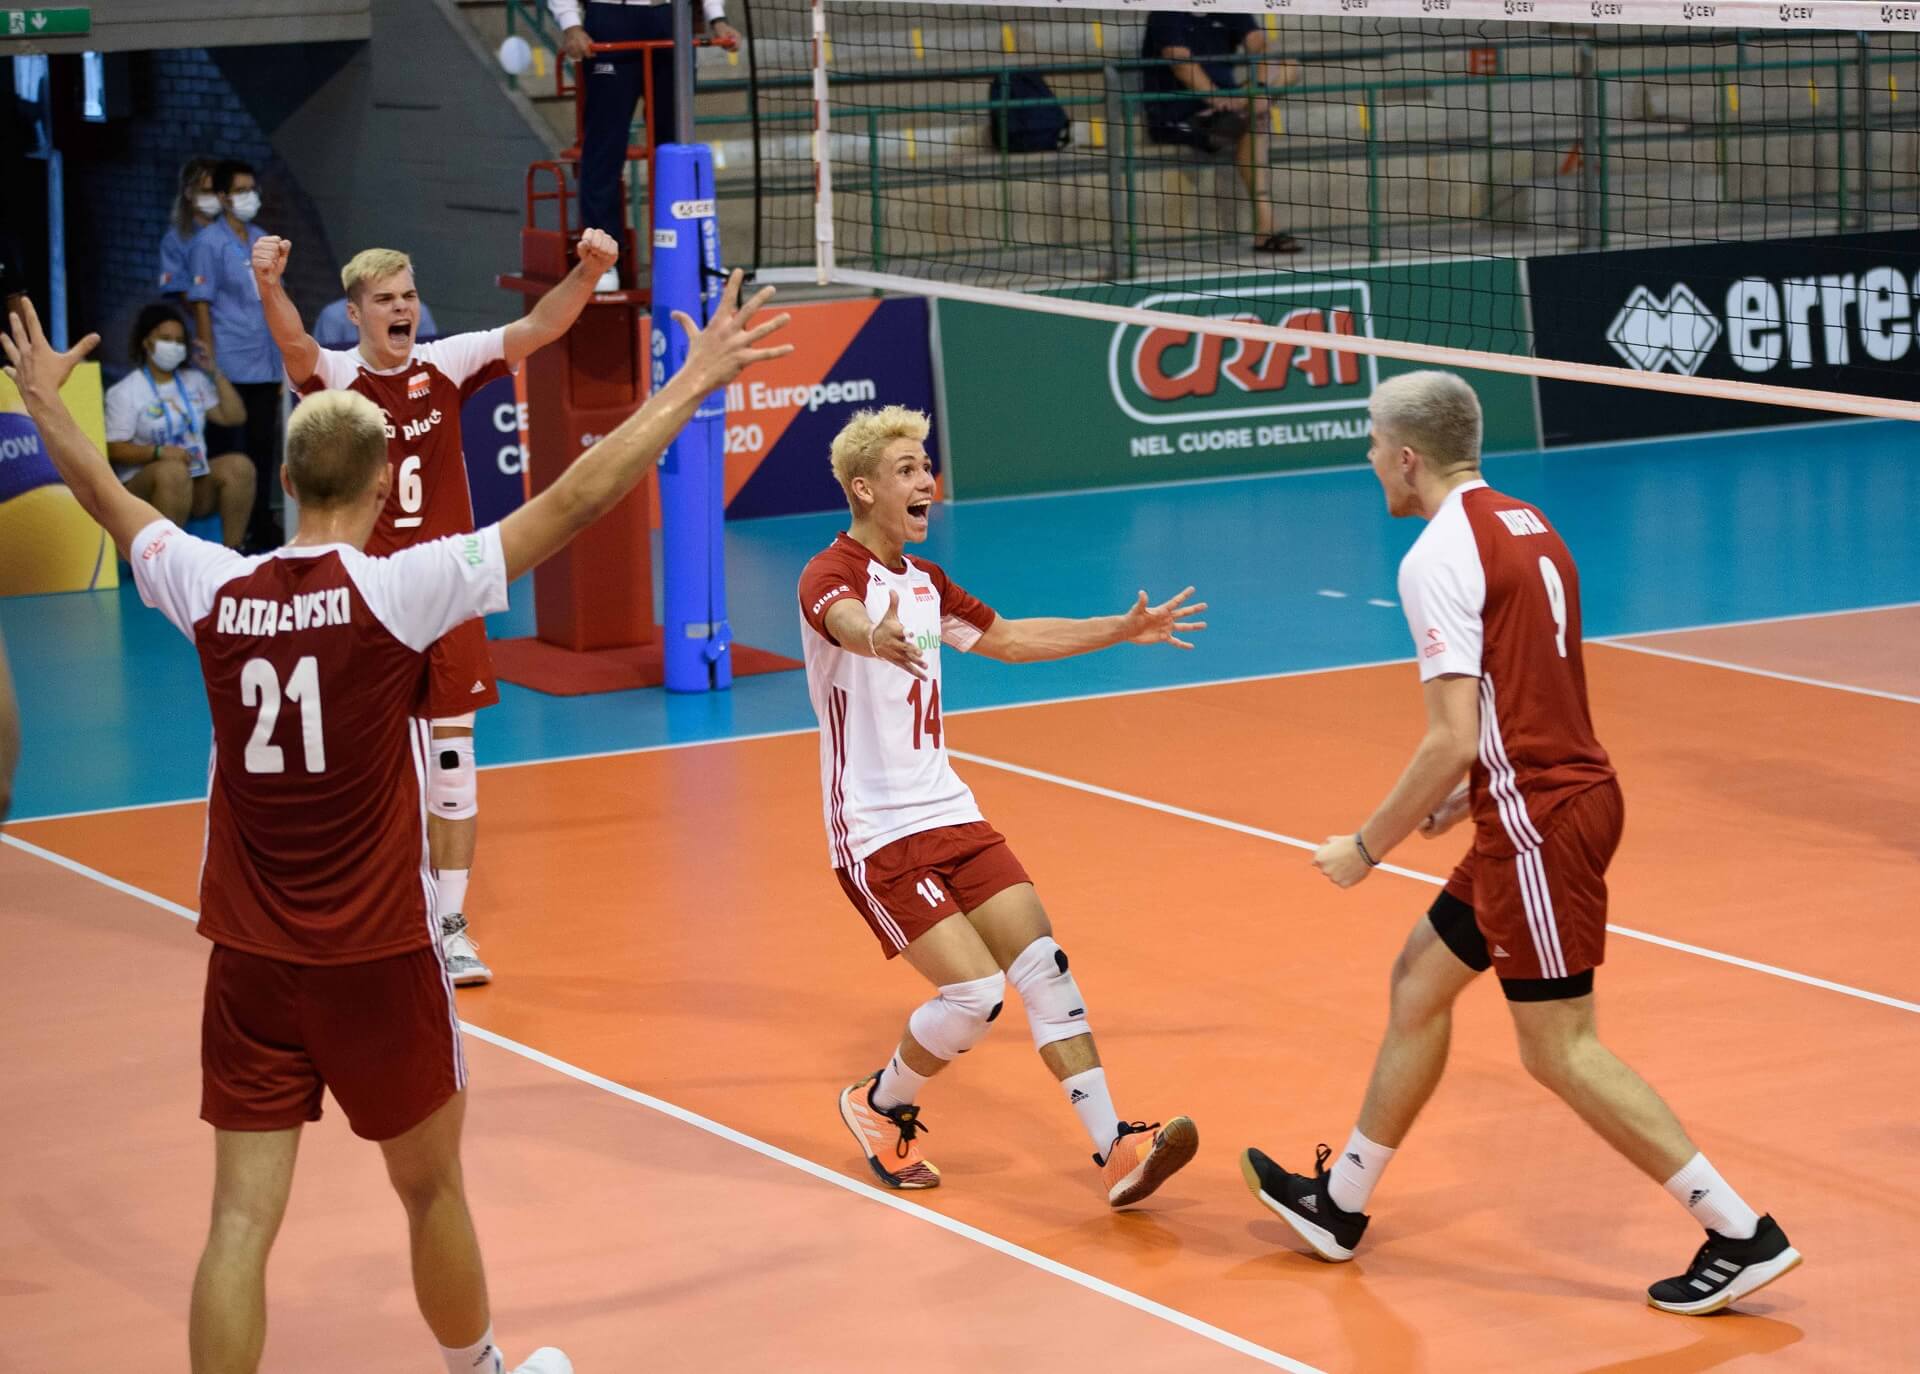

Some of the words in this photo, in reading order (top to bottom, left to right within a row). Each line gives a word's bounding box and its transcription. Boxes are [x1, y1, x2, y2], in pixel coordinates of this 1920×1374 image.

[1516, 2, 1535, 12] CEV
[1604, 4, 1623, 15] CEV
[1696, 6, 1716, 17] CEV
[1793, 7, 1814, 19] CEV
[1895, 8, 1918, 20] CEV
[1726, 266, 1920, 373] erre
[1132, 305, 1360, 402] CRAI
[750, 379, 876, 412] European
[402, 408, 442, 441] plu
[1130, 435, 1174, 457] NEL
[1178, 428, 1254, 453] CUORE
[399, 455, 422, 514] 6
[216, 586, 351, 637] RATAEWSKI
[1538, 555, 1567, 658] 9
[240, 655, 326, 774] 21
[906, 678, 941, 750] 14
[916, 877, 946, 908] 14
